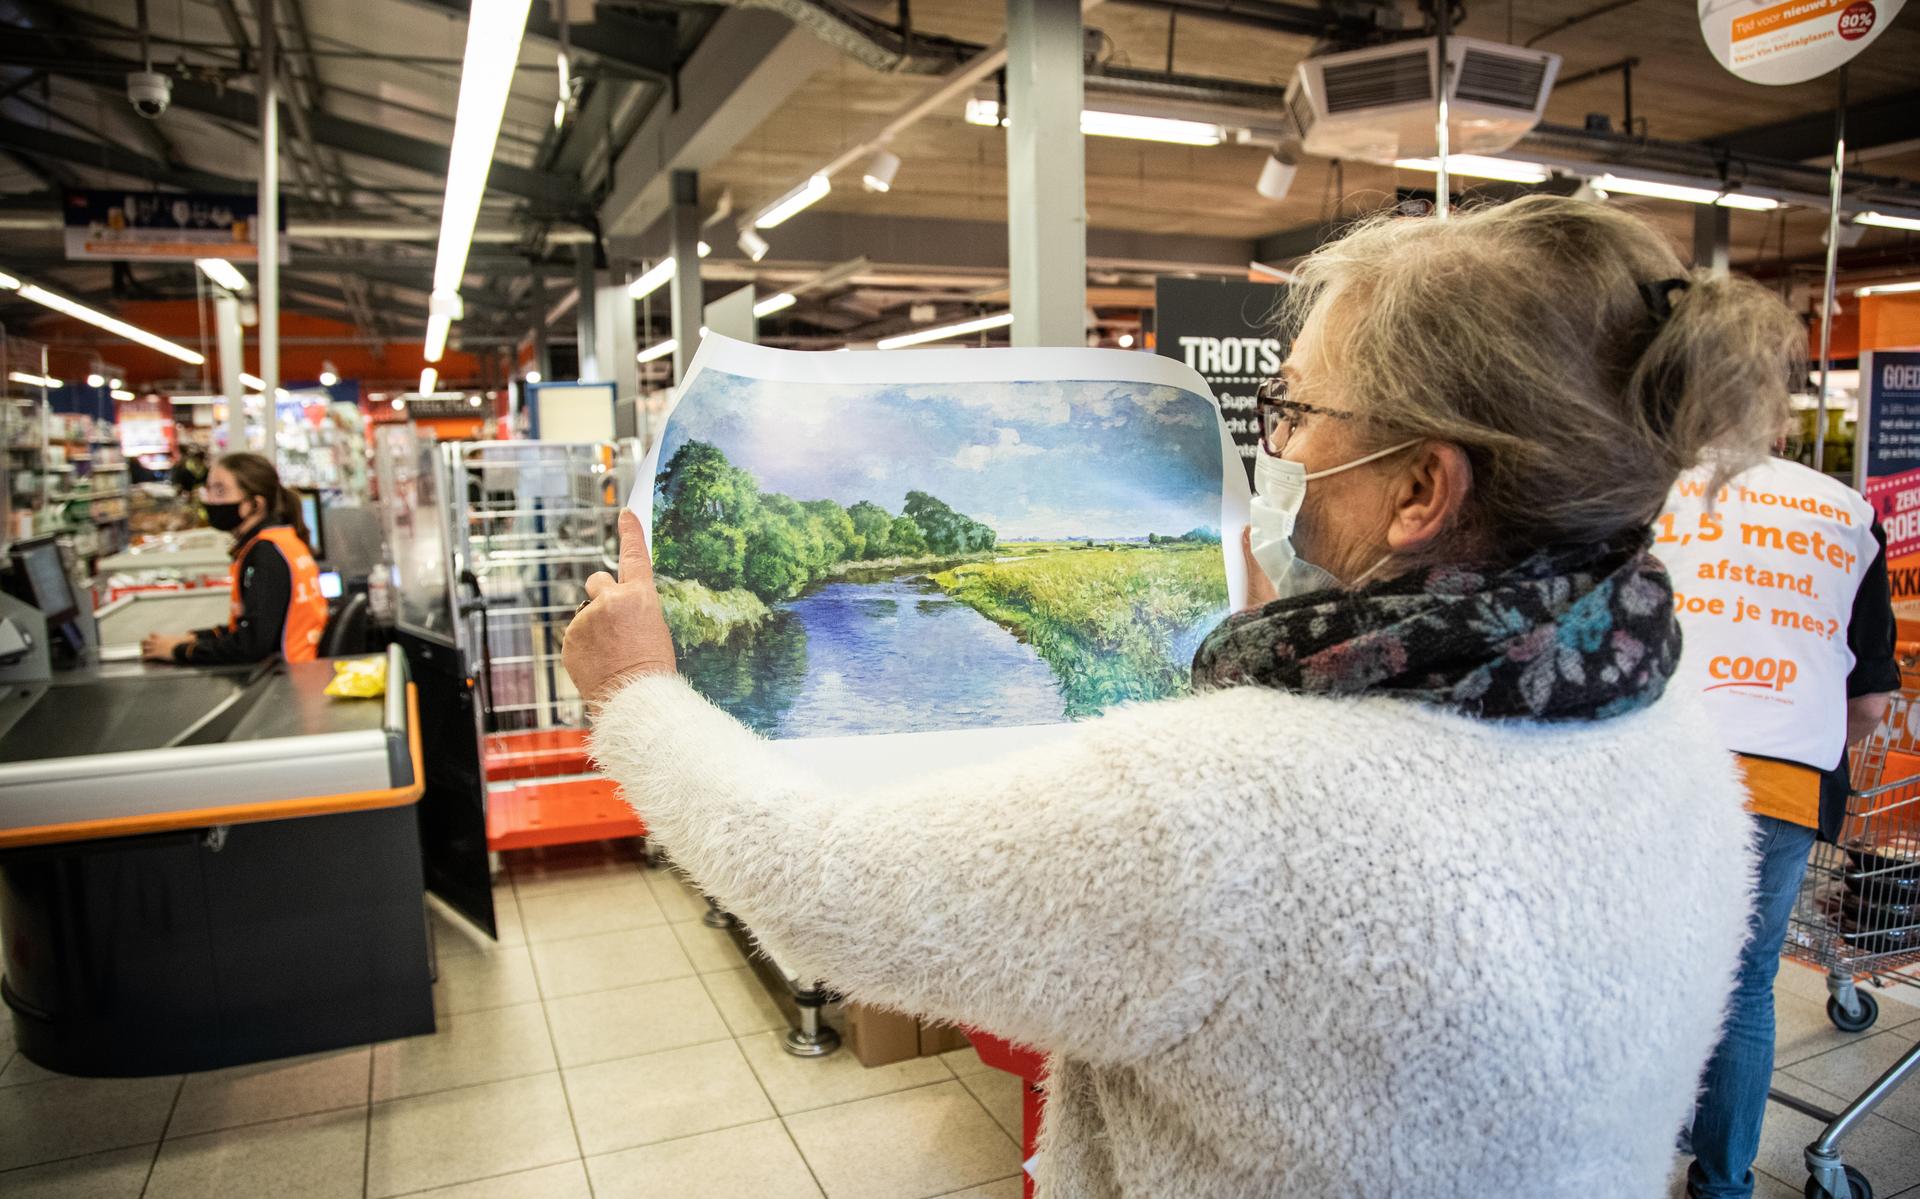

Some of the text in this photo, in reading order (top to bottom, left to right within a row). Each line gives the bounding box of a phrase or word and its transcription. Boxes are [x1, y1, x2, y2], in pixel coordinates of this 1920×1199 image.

[1735, 19, 1755, 33] Tijd
[1757, 13, 1781, 26] voor
[1783, 0, 1827, 19] nieuwe
[1841, 12, 1872, 28] 80%
[1178, 336, 1281, 374] TROTS
[1221, 392, 1259, 412] Supe
[1677, 480, 1851, 526] Wj houden
[1656, 511, 1856, 574] 1,5 meter
[1882, 511, 1920, 545] GOE
[1697, 560, 1819, 600] afstand.
[1888, 567, 1920, 597] KK
[1733, 596, 1761, 623] je
[1771, 607, 1839, 640] mee?
[1708, 655, 1797, 691] coop
